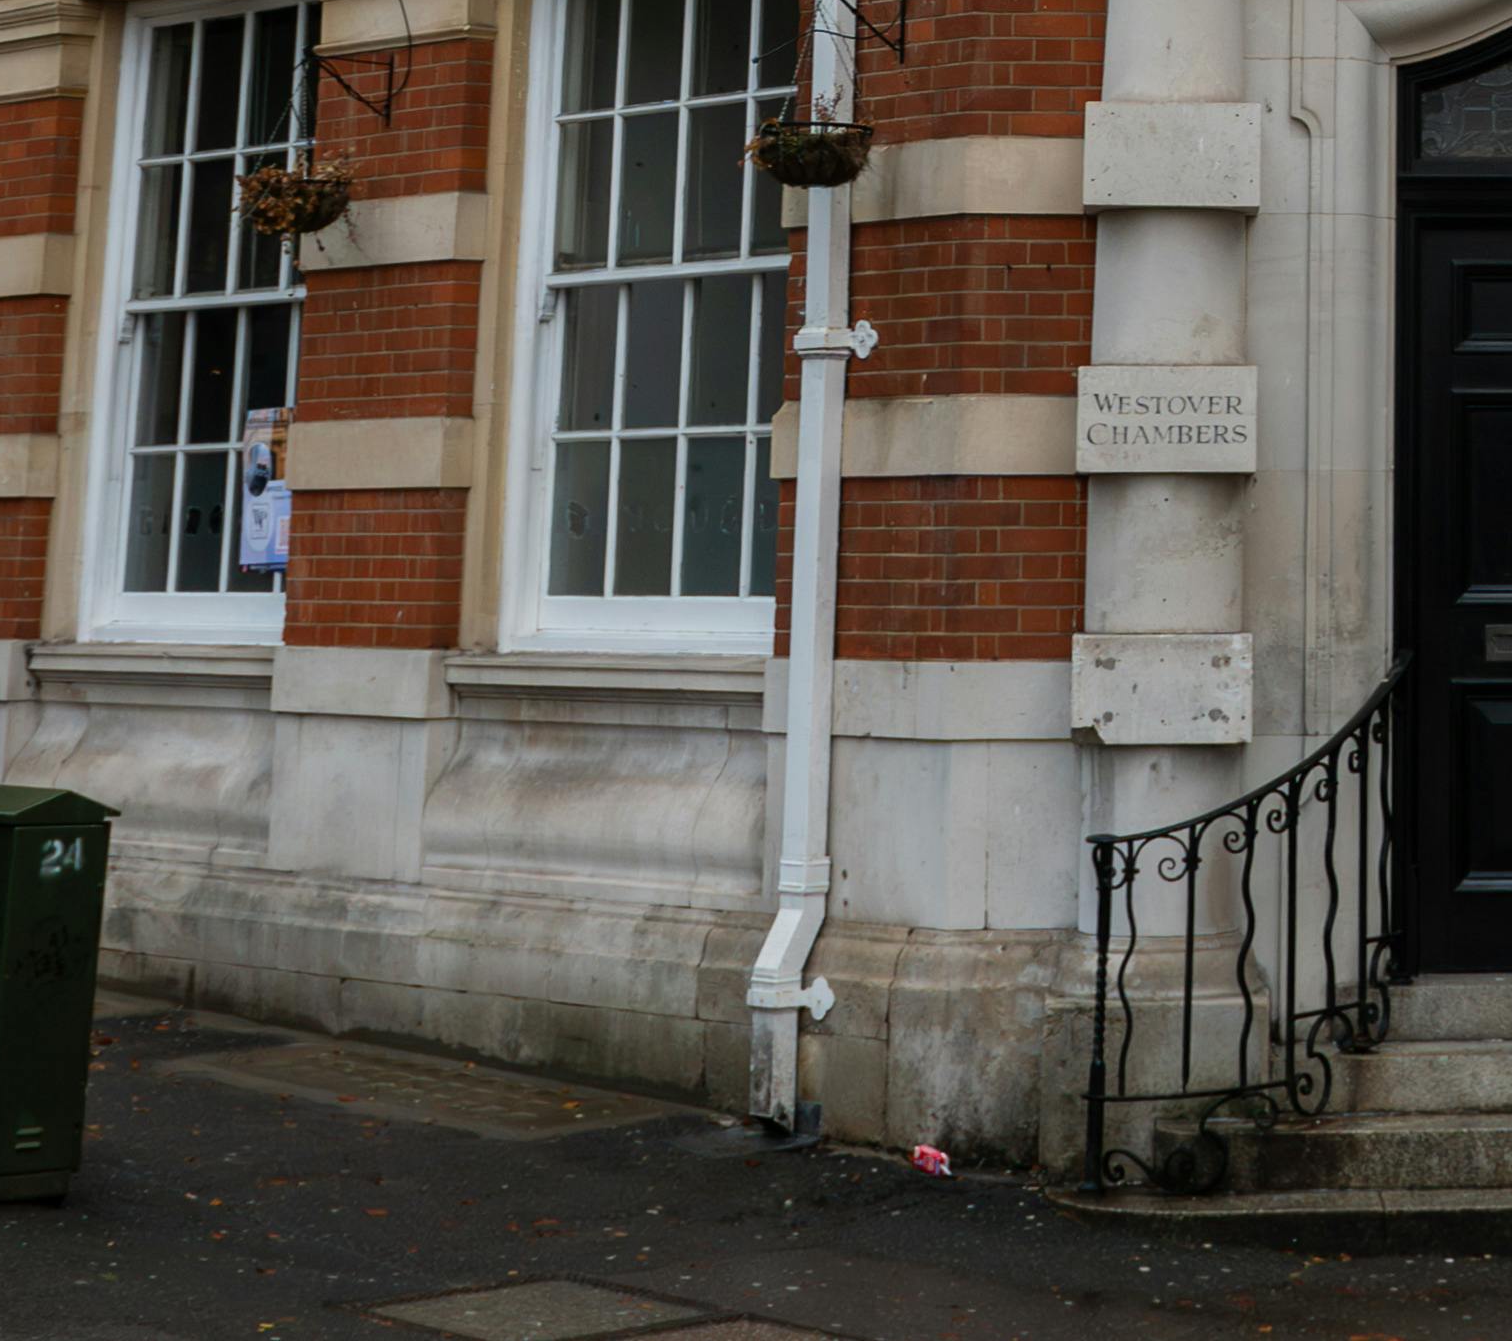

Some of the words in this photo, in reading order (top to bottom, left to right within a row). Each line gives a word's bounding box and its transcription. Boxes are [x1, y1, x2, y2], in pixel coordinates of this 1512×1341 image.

[1093, 393, 1244, 416] WESTOVER
[1086, 422, 1248, 446] CHAMBERS
[39, 836, 84, 877] 24
